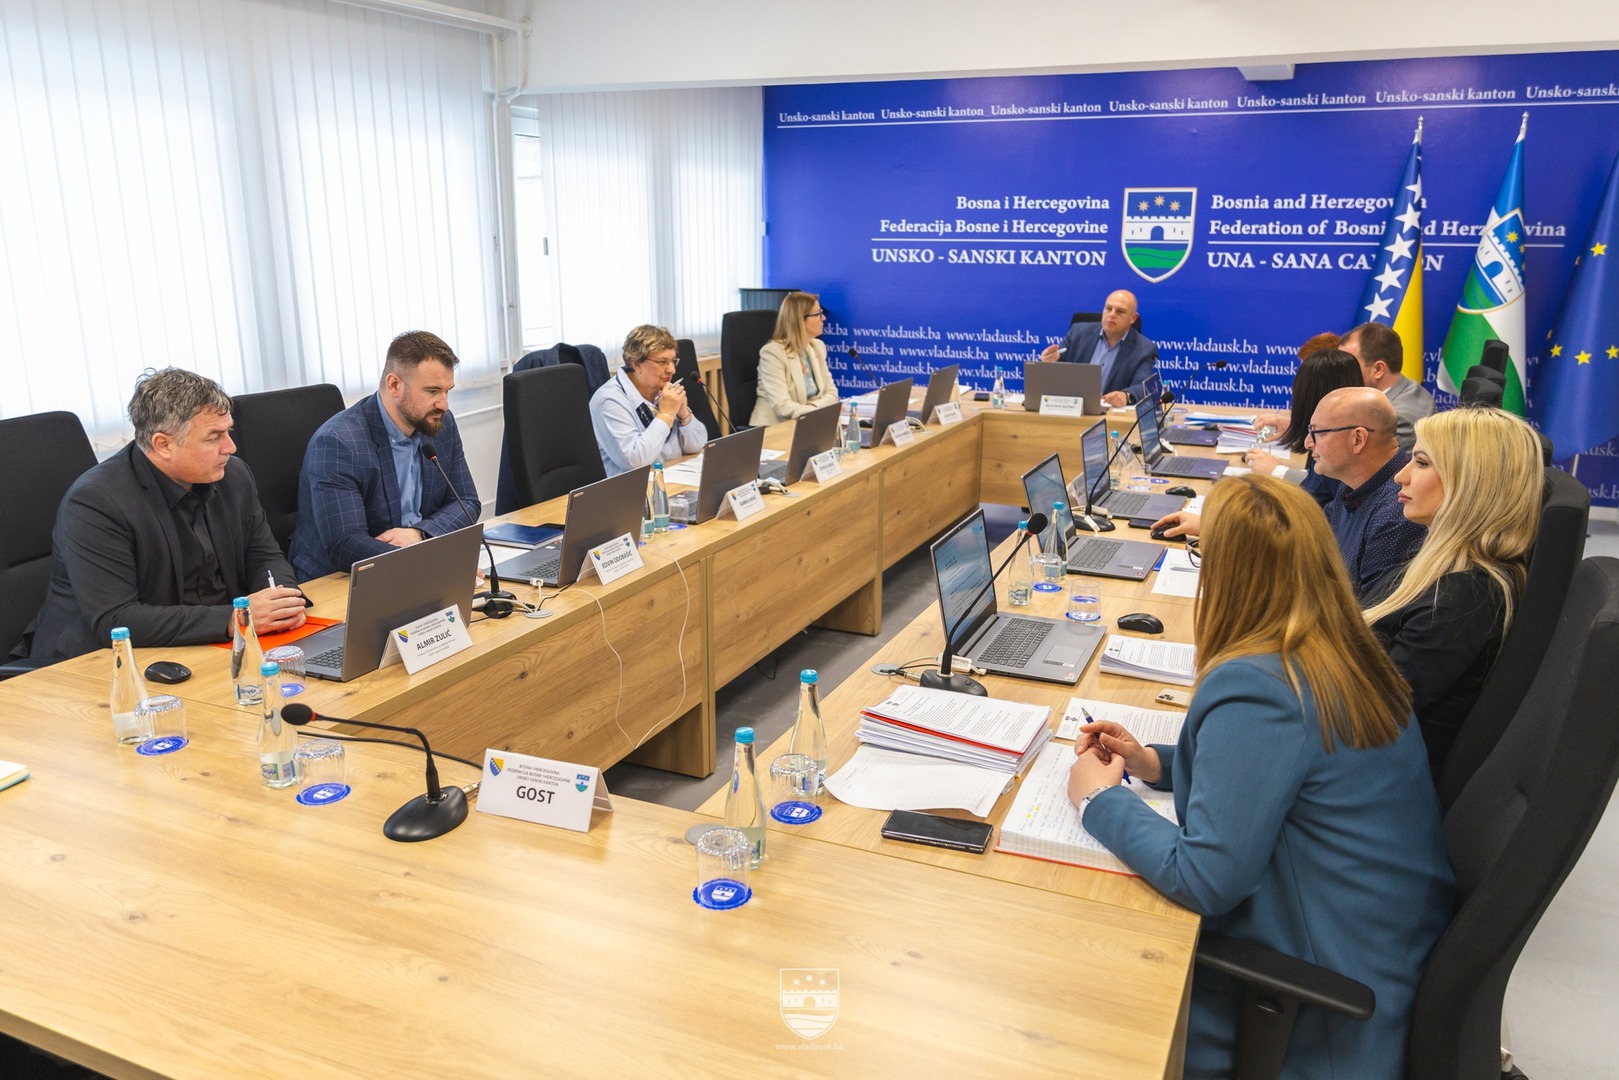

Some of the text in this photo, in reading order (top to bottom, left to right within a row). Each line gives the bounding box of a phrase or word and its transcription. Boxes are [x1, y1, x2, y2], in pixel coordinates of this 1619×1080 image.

[779, 111, 840, 123] Unsko-sanski
[841, 110, 875, 121] kanton
[881, 107, 946, 120] Unsko-sanski
[948, 106, 984, 118] kanton
[991, 103, 1062, 116] Unsko-sanski
[1063, 102, 1102, 114] kanton
[1109, 98, 1185, 112] Unsko-sanski
[1187, 97, 1229, 110] kanton
[1237, 93, 1319, 108] Unsko-sanski
[1321, 92, 1366, 105] kanton
[1375, 88, 1464, 104] Unsko-sanski
[1467, 87, 1516, 101] kanton
[956, 196, 1110, 213] Bosna i Hercegovina
[1211, 193, 1428, 214] Bosnia and Herzegova
[880, 219, 1108, 237] Federacija Bosne i Hercegovine
[1209, 220, 1303, 236] Federation
[1307, 219, 1329, 235] of
[1333, 220, 1387, 236] Bosni
[1440, 221, 1566, 237] Herzvina
[872, 248, 935, 264] UNSKO
[948, 249, 1015, 265] SANSKI
[1019, 250, 1107, 266] KANTON
[1207, 252, 1256, 268] UNA
[1271, 252, 1333, 270] SANA
[853, 325, 941, 340] www.vladausk.ba
[946, 329, 1040, 344] www.vladausk.ba
[826, 341, 894, 356] w.vladausk.ba
[899, 344, 989, 360] www.vladausk.ba
[416, 638, 435, 651] ALMIR
[435, 629, 452, 643] ZULIĆ
[516, 785, 555, 804] GOST
